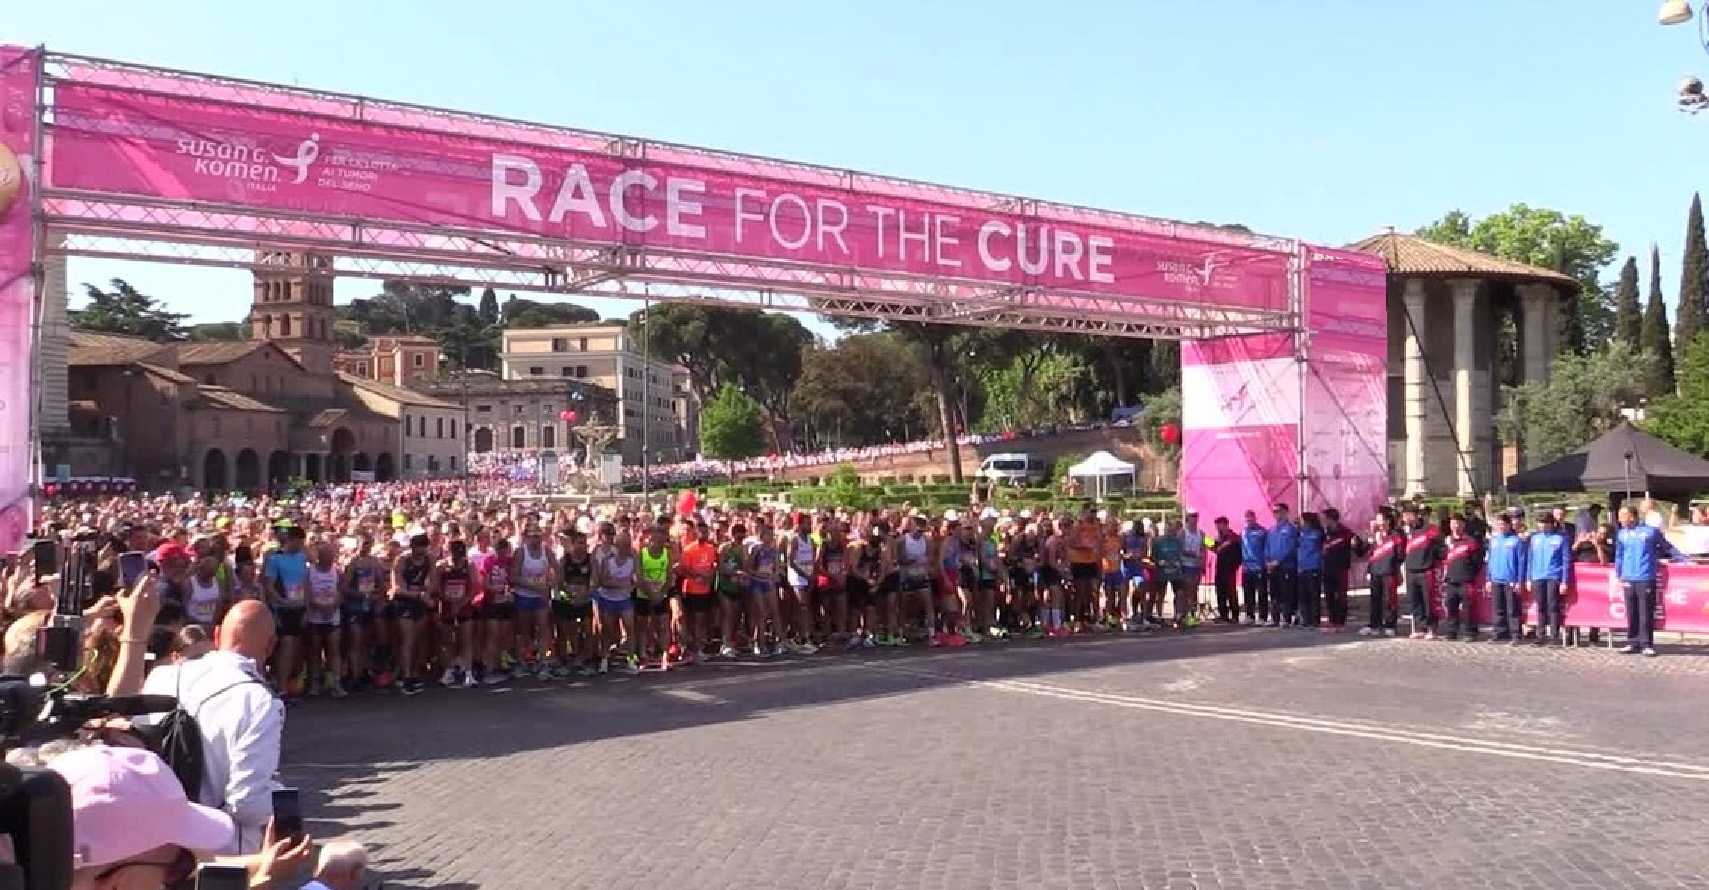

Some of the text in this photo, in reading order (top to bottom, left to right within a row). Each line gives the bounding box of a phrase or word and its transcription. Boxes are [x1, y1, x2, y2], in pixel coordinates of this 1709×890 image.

[491, 152, 1115, 284] RACE FOR THE CURE
